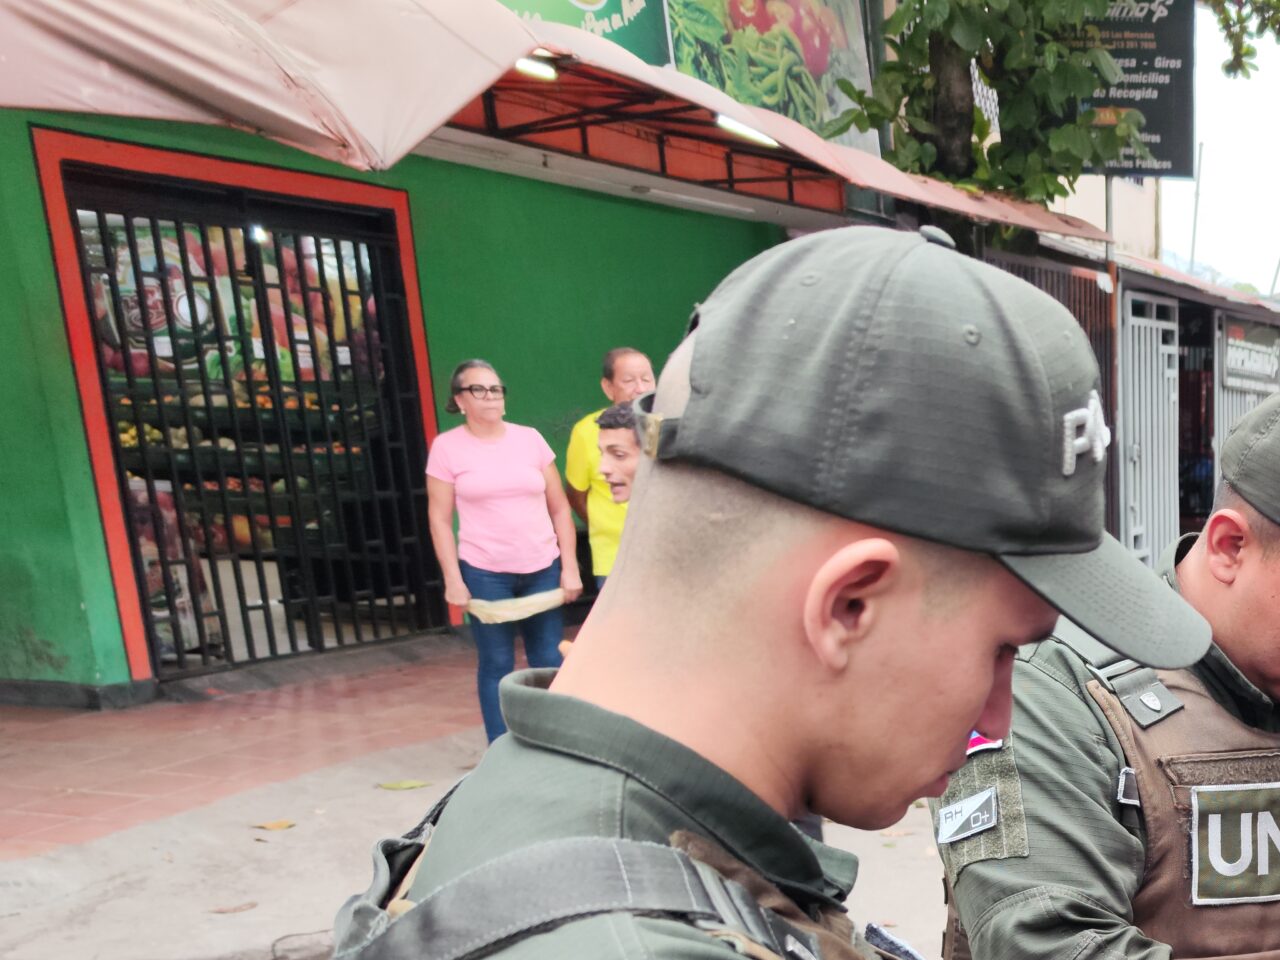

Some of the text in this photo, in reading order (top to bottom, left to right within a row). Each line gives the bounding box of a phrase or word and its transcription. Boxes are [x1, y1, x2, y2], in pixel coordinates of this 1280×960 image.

[1154, 56, 1182, 69] Giros
[1109, 87, 1158, 100] Recogida
[944, 808, 963, 823] RH
